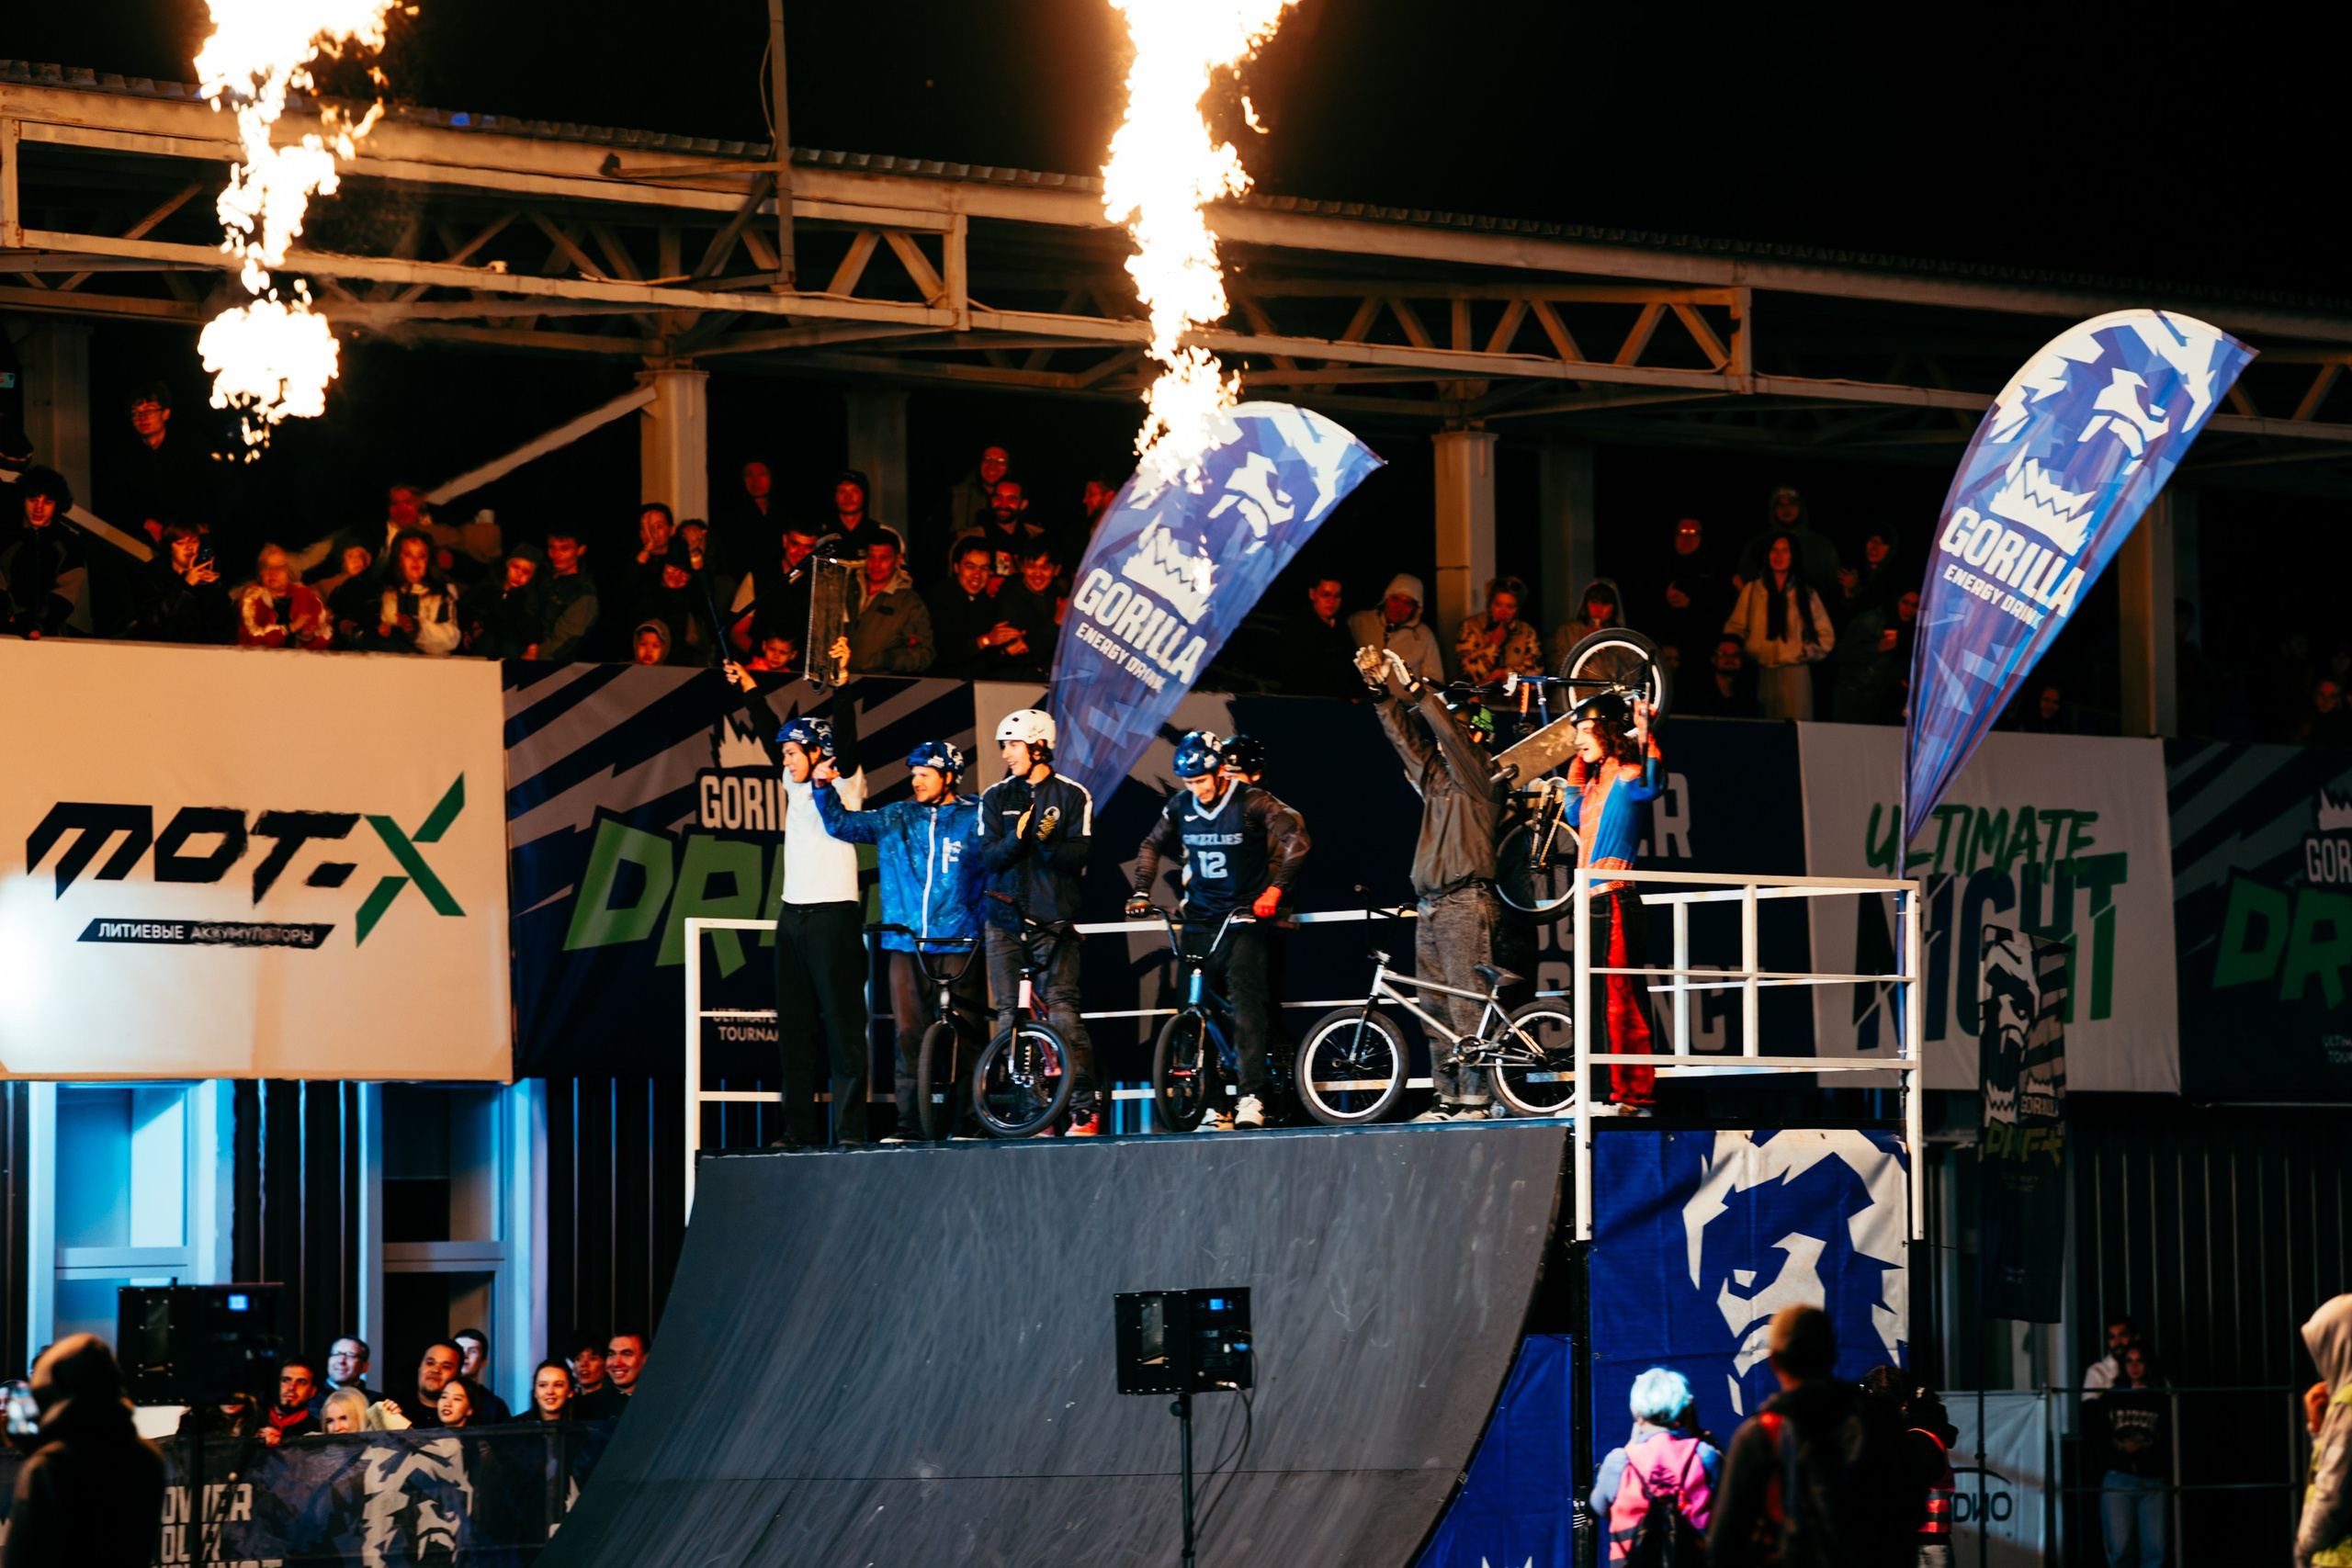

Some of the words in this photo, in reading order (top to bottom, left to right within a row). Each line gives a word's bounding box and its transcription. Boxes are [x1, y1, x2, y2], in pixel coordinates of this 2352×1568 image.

[1939, 506, 2086, 618] GORILLA
[1943, 563, 2005, 605] ENERGY
[1999, 594, 2045, 630] DRINK
[1073, 568, 1208, 684] GORILLA
[1075, 622, 1130, 665] ENERGY
[1125, 656, 1168, 694] DRINK
[699, 774, 786, 831] GORI
[1182, 832, 1244, 846] GRIZZLIES
[1197, 851, 1228, 879] 12
[97, 922, 185, 940] ЛИТИЕВЫЕ
[718, 1026, 779, 1042] TOURNA
